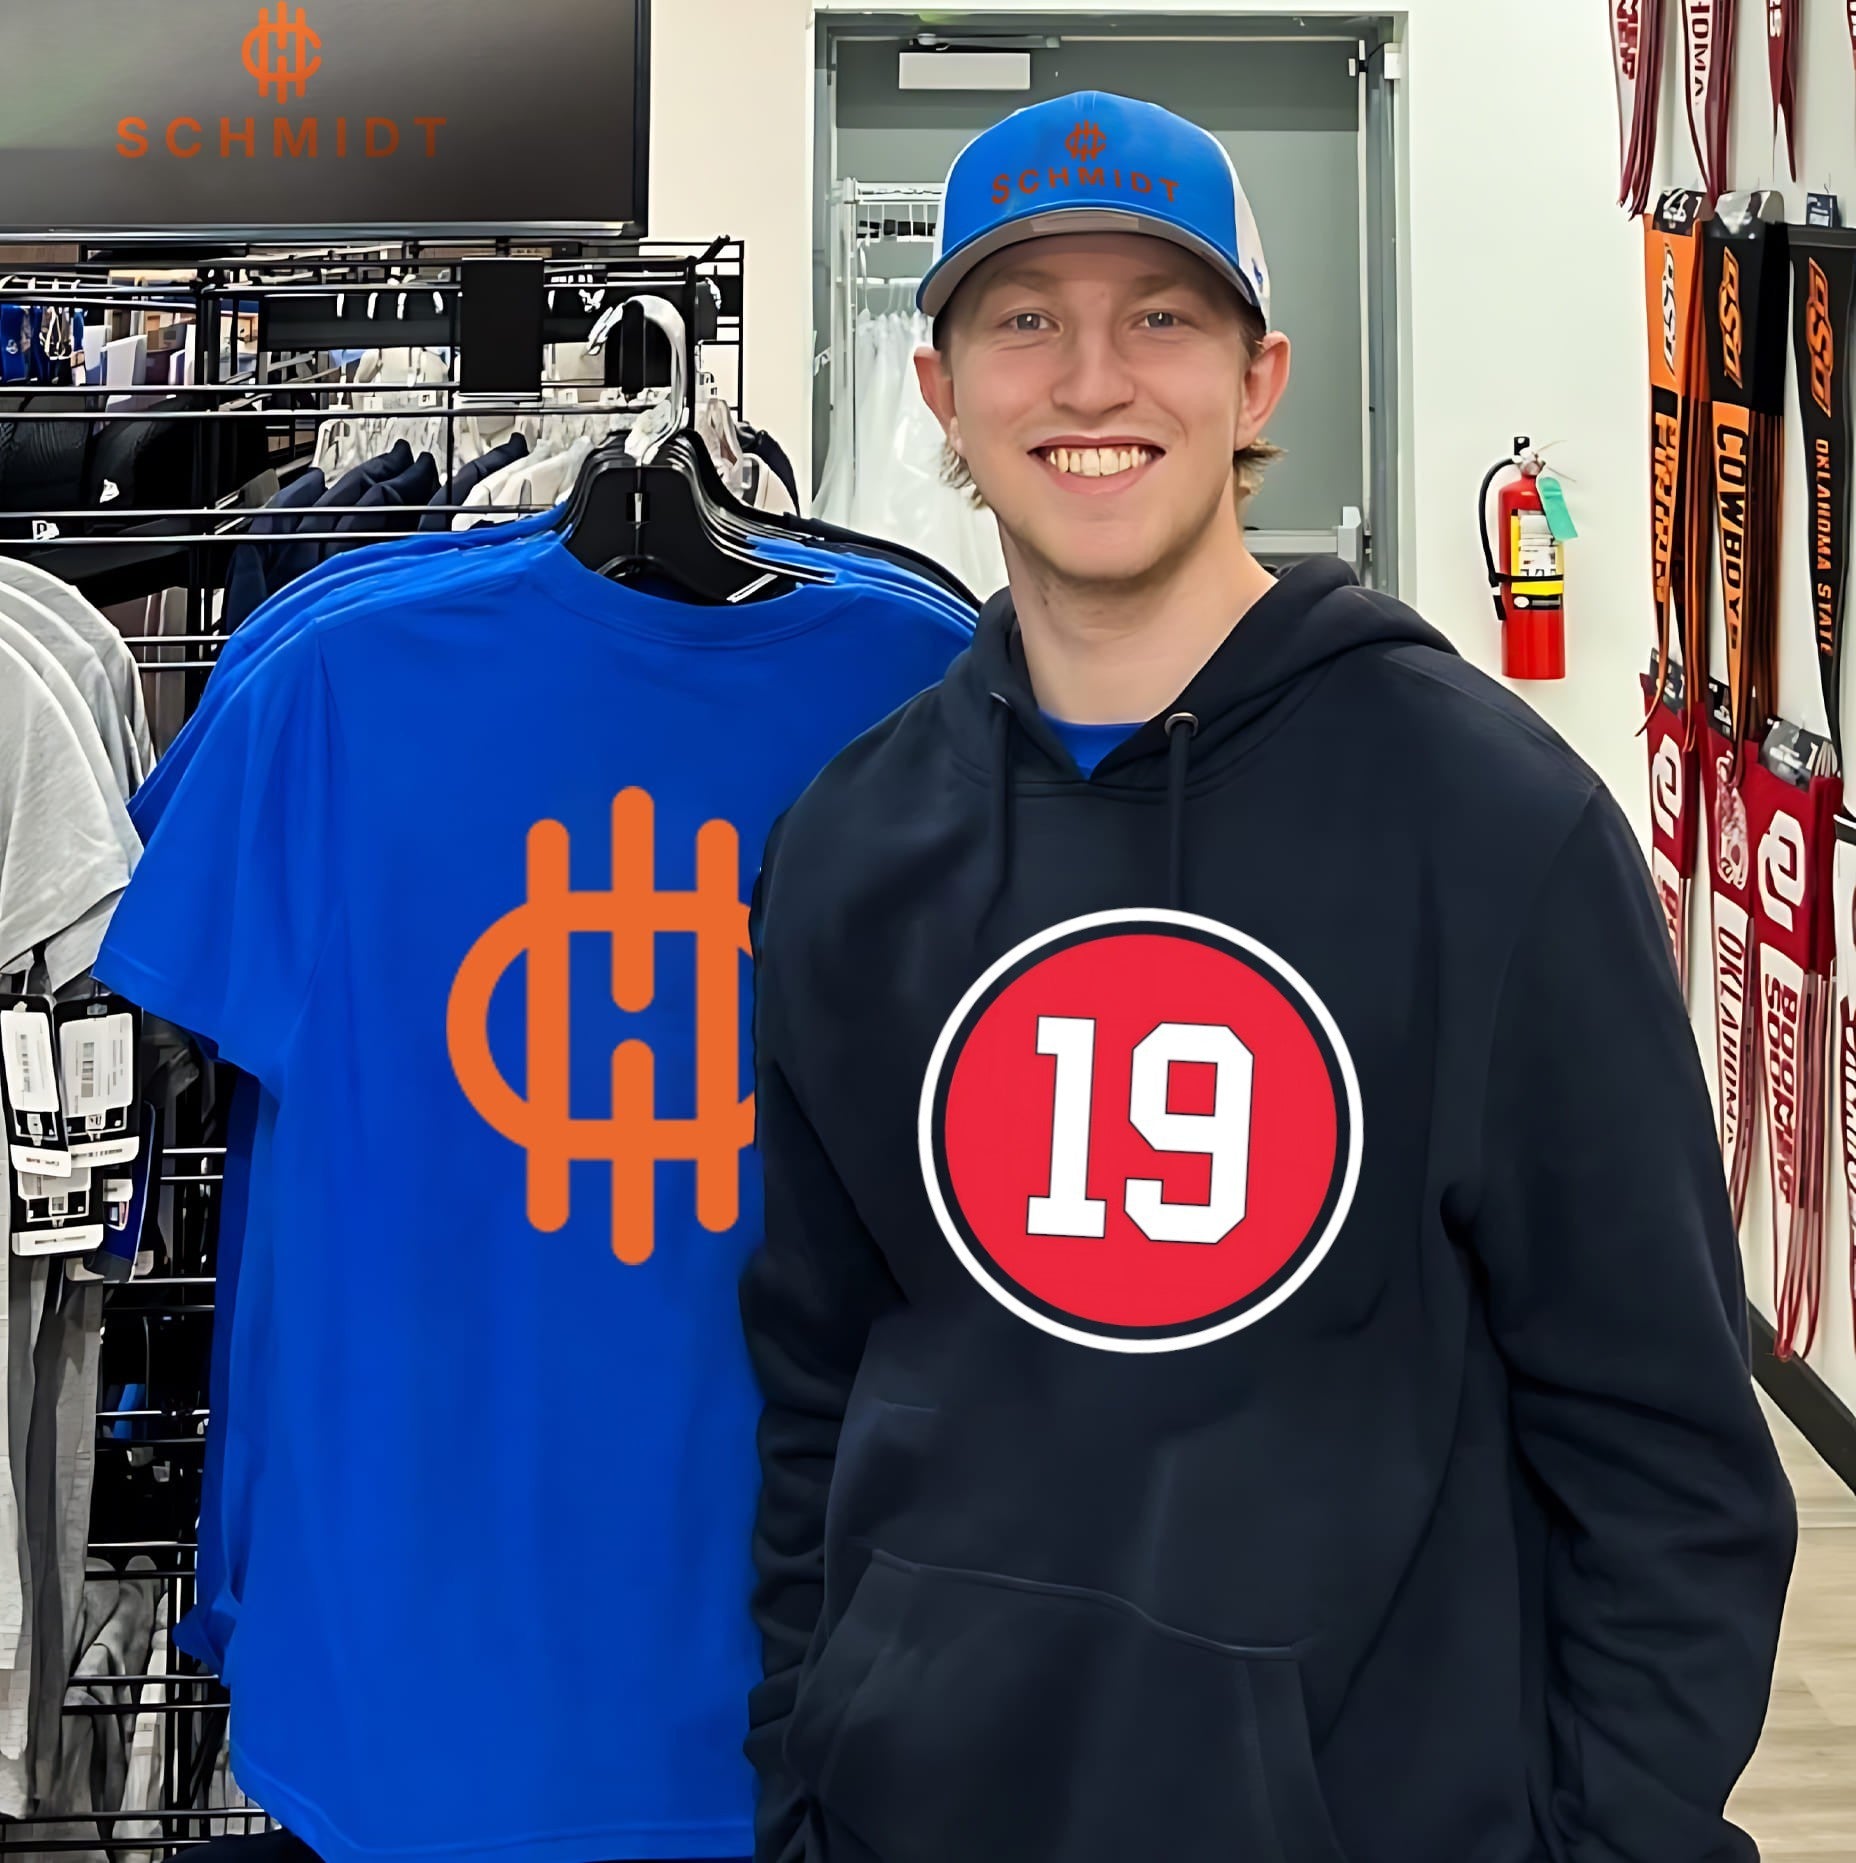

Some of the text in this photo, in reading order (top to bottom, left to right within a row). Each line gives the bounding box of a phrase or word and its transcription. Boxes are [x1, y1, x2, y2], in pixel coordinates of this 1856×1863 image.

[115, 117, 448, 159] SCHMIDT
[991, 166, 1180, 204] SCHMIDT
[1815, 438, 1833, 570] OKLAHOMA
[1718, 926, 1745, 1144] OKLAHOMA
[1026, 1014, 1255, 1245] 19
